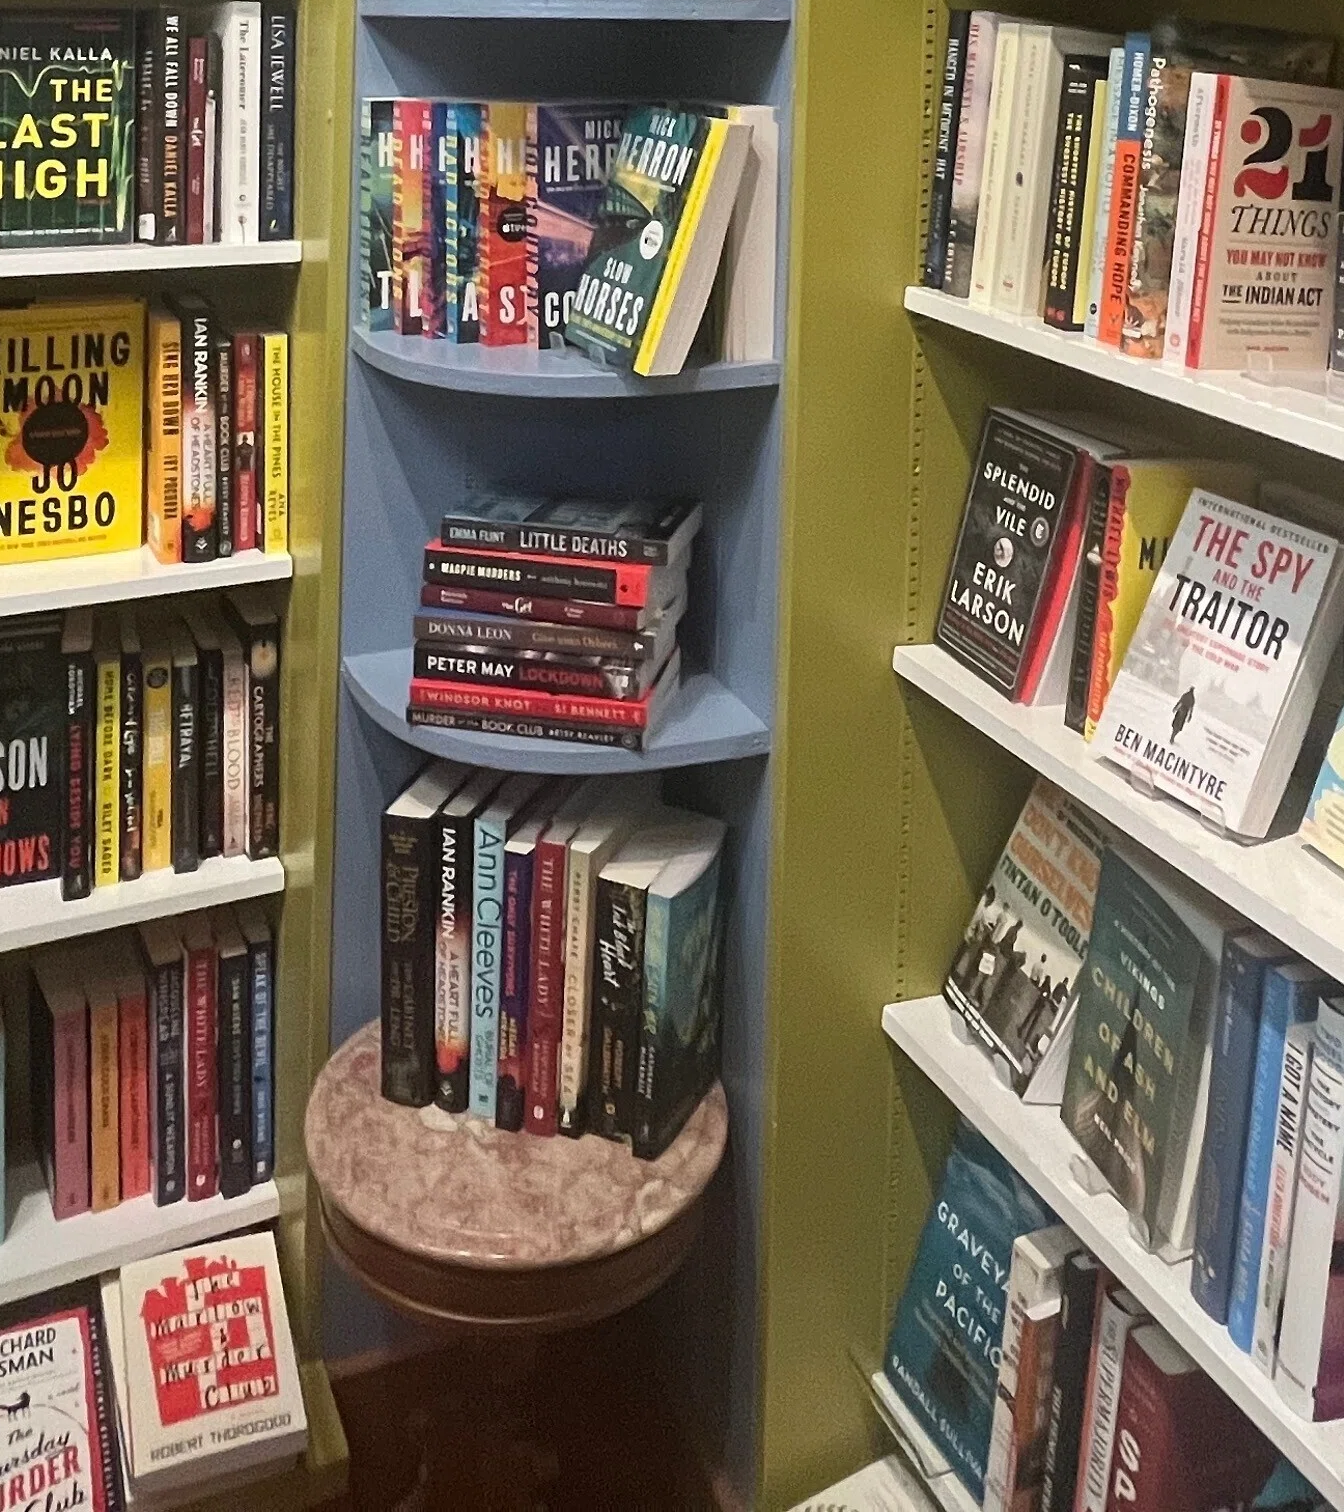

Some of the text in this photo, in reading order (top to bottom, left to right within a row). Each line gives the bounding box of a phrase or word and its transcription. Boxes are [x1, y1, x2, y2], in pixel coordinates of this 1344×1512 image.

[50, 46, 113, 62] KALLA
[50, 78, 113, 103] THE
[618, 133, 696, 186] HERRON
[1233, 106, 1335, 201] 21
[1108, 153, 1136, 305] COMMANDING HOPE
[1231, 205, 1332, 239] THINGS
[603, 257, 632, 284] SLOW
[1227, 249, 1326, 269] YOU MAY NOT KNOW
[1256, 271, 1298, 282] ABOUT
[573, 273, 644, 336] HORSES
[1222, 284, 1323, 306] THE INDIAN ACT
[2, 372, 111, 412] MOON
[31, 467, 79, 495] JO
[982, 461, 1056, 512] SPLENDID
[995, 506, 1028, 537] VILE
[520, 531, 627, 557] LITTLE DEATHS
[1191, 515, 1315, 594] THE SPY
[972, 561, 1017, 605] ERIK
[949, 580, 1025, 646] LARSON
[1169, 574, 1289, 661] TRAITOR
[427, 657, 513, 678] PETER MAY
[1114, 724, 1227, 801] BEN MACINTYRE
[441, 829, 455, 940] IAN RANKIN
